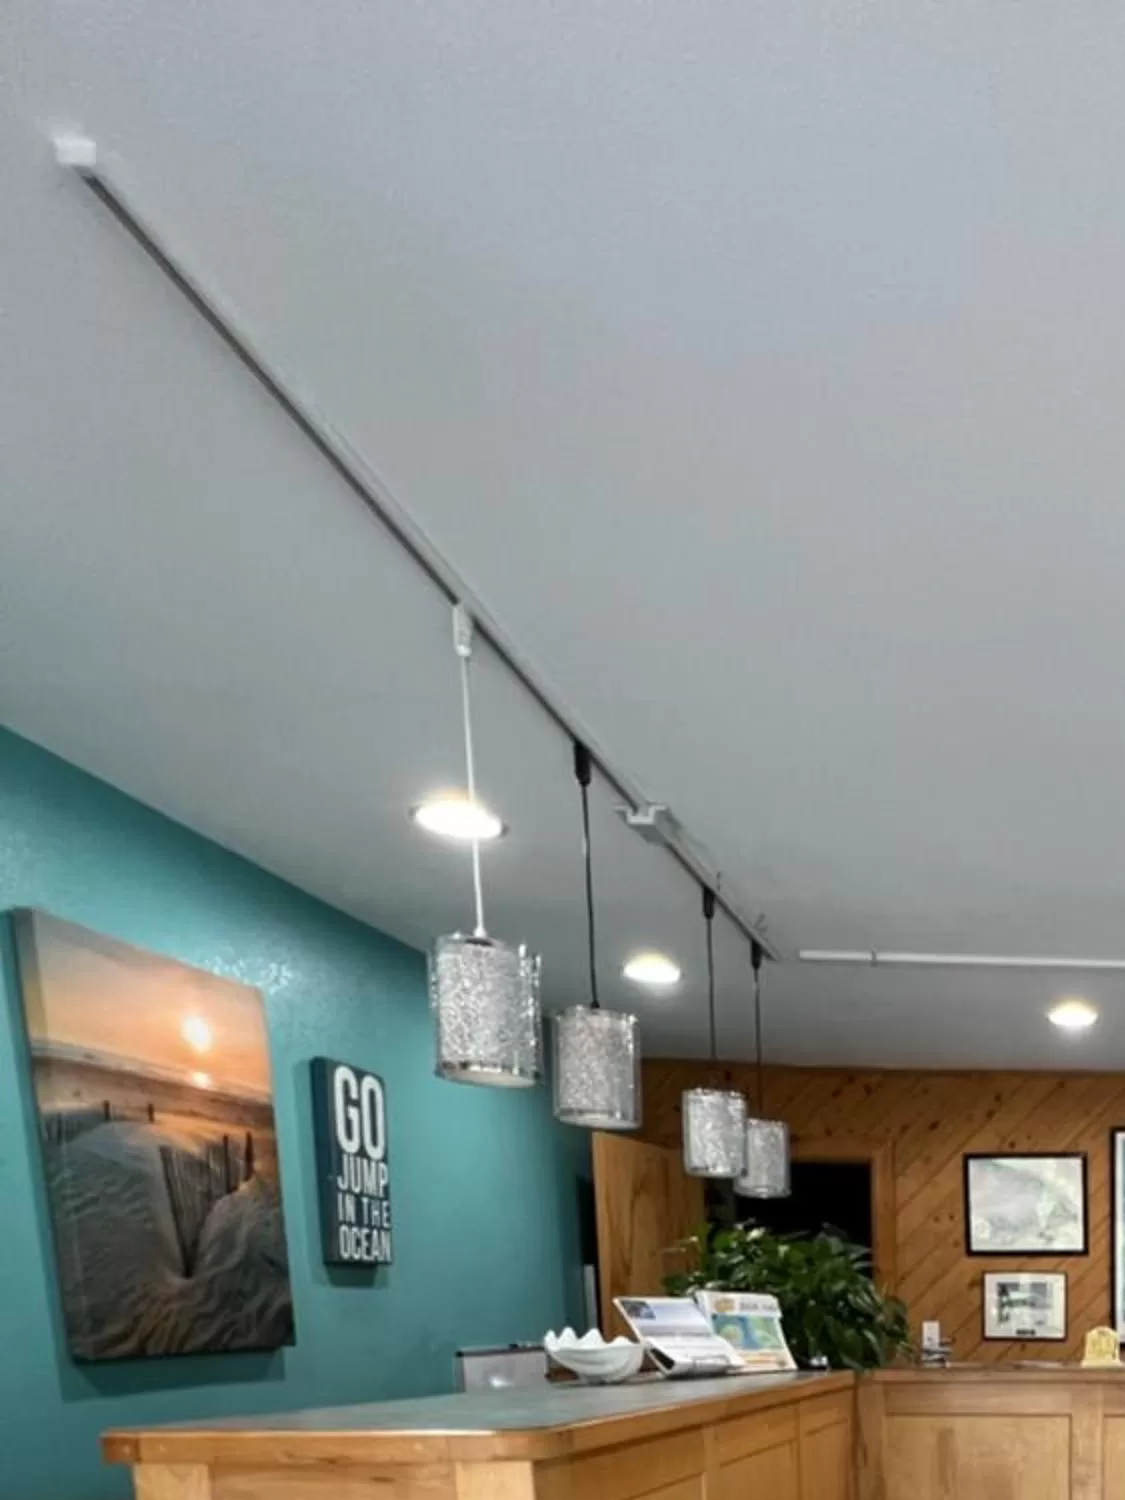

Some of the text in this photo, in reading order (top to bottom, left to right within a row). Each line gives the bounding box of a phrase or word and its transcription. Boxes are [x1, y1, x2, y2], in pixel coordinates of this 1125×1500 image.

[334, 1065, 385, 1161] GO
[337, 1153, 389, 1198] JUMP
[337, 1192, 391, 1228] IN THE
[339, 1224, 392, 1262] OCEAN
